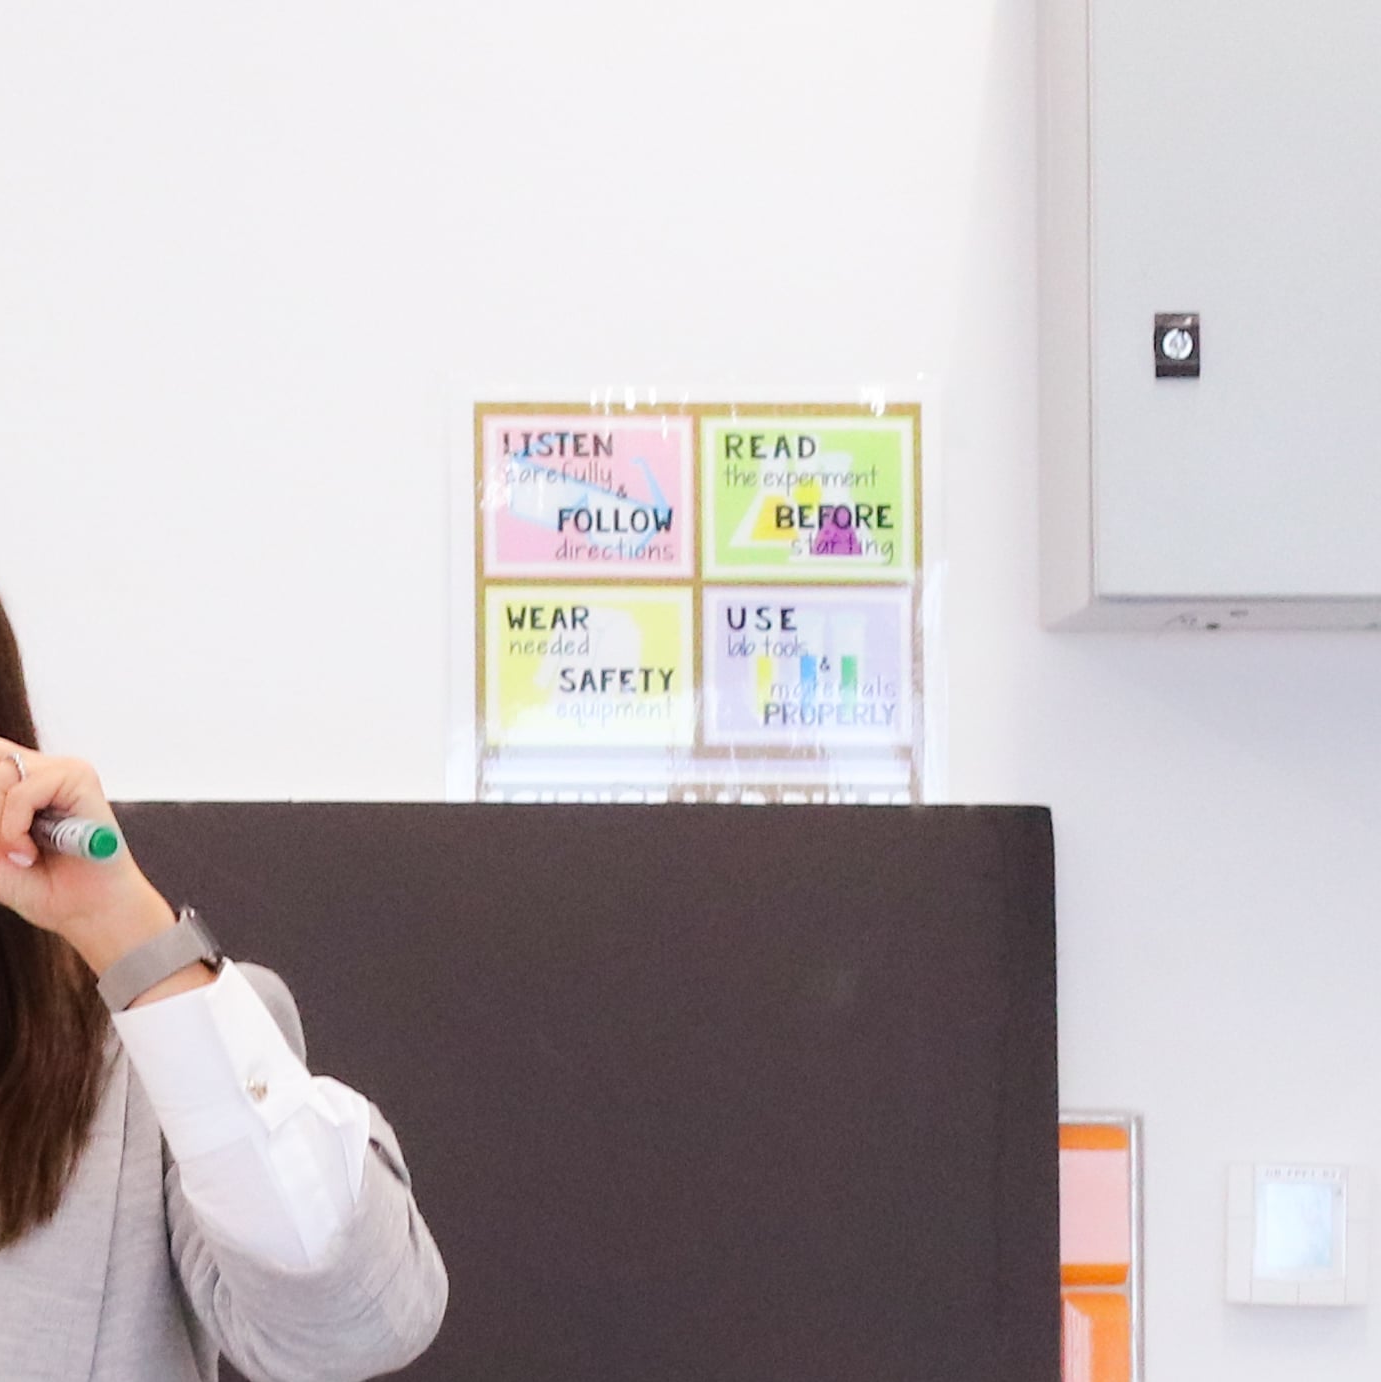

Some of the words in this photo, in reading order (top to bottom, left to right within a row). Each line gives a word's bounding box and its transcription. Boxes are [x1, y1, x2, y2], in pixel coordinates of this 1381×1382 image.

[503, 432, 613, 458] LISTEN
[724, 434, 817, 460] READ
[503, 463, 613, 493] carefully
[724, 465, 758, 488] the
[763, 467, 878, 499] experiment
[616, 484, 628, 500] &
[557, 507, 674, 534] FOLLOW
[775, 505, 894, 530] BEFORE
[555, 536, 675, 562] directions
[791, 536, 894, 568] starting
[506, 606, 590, 631] WEAR
[726, 606, 798, 631] USE
[509, 634, 590, 656] needed
[727, 634, 756, 657] lab
[763, 634, 808, 658] tools
[819, 656, 831, 673] &
[559, 668, 675, 693] SAFETY
[555, 696, 673, 729] equipment
[764, 703, 896, 727] PROPERLY
